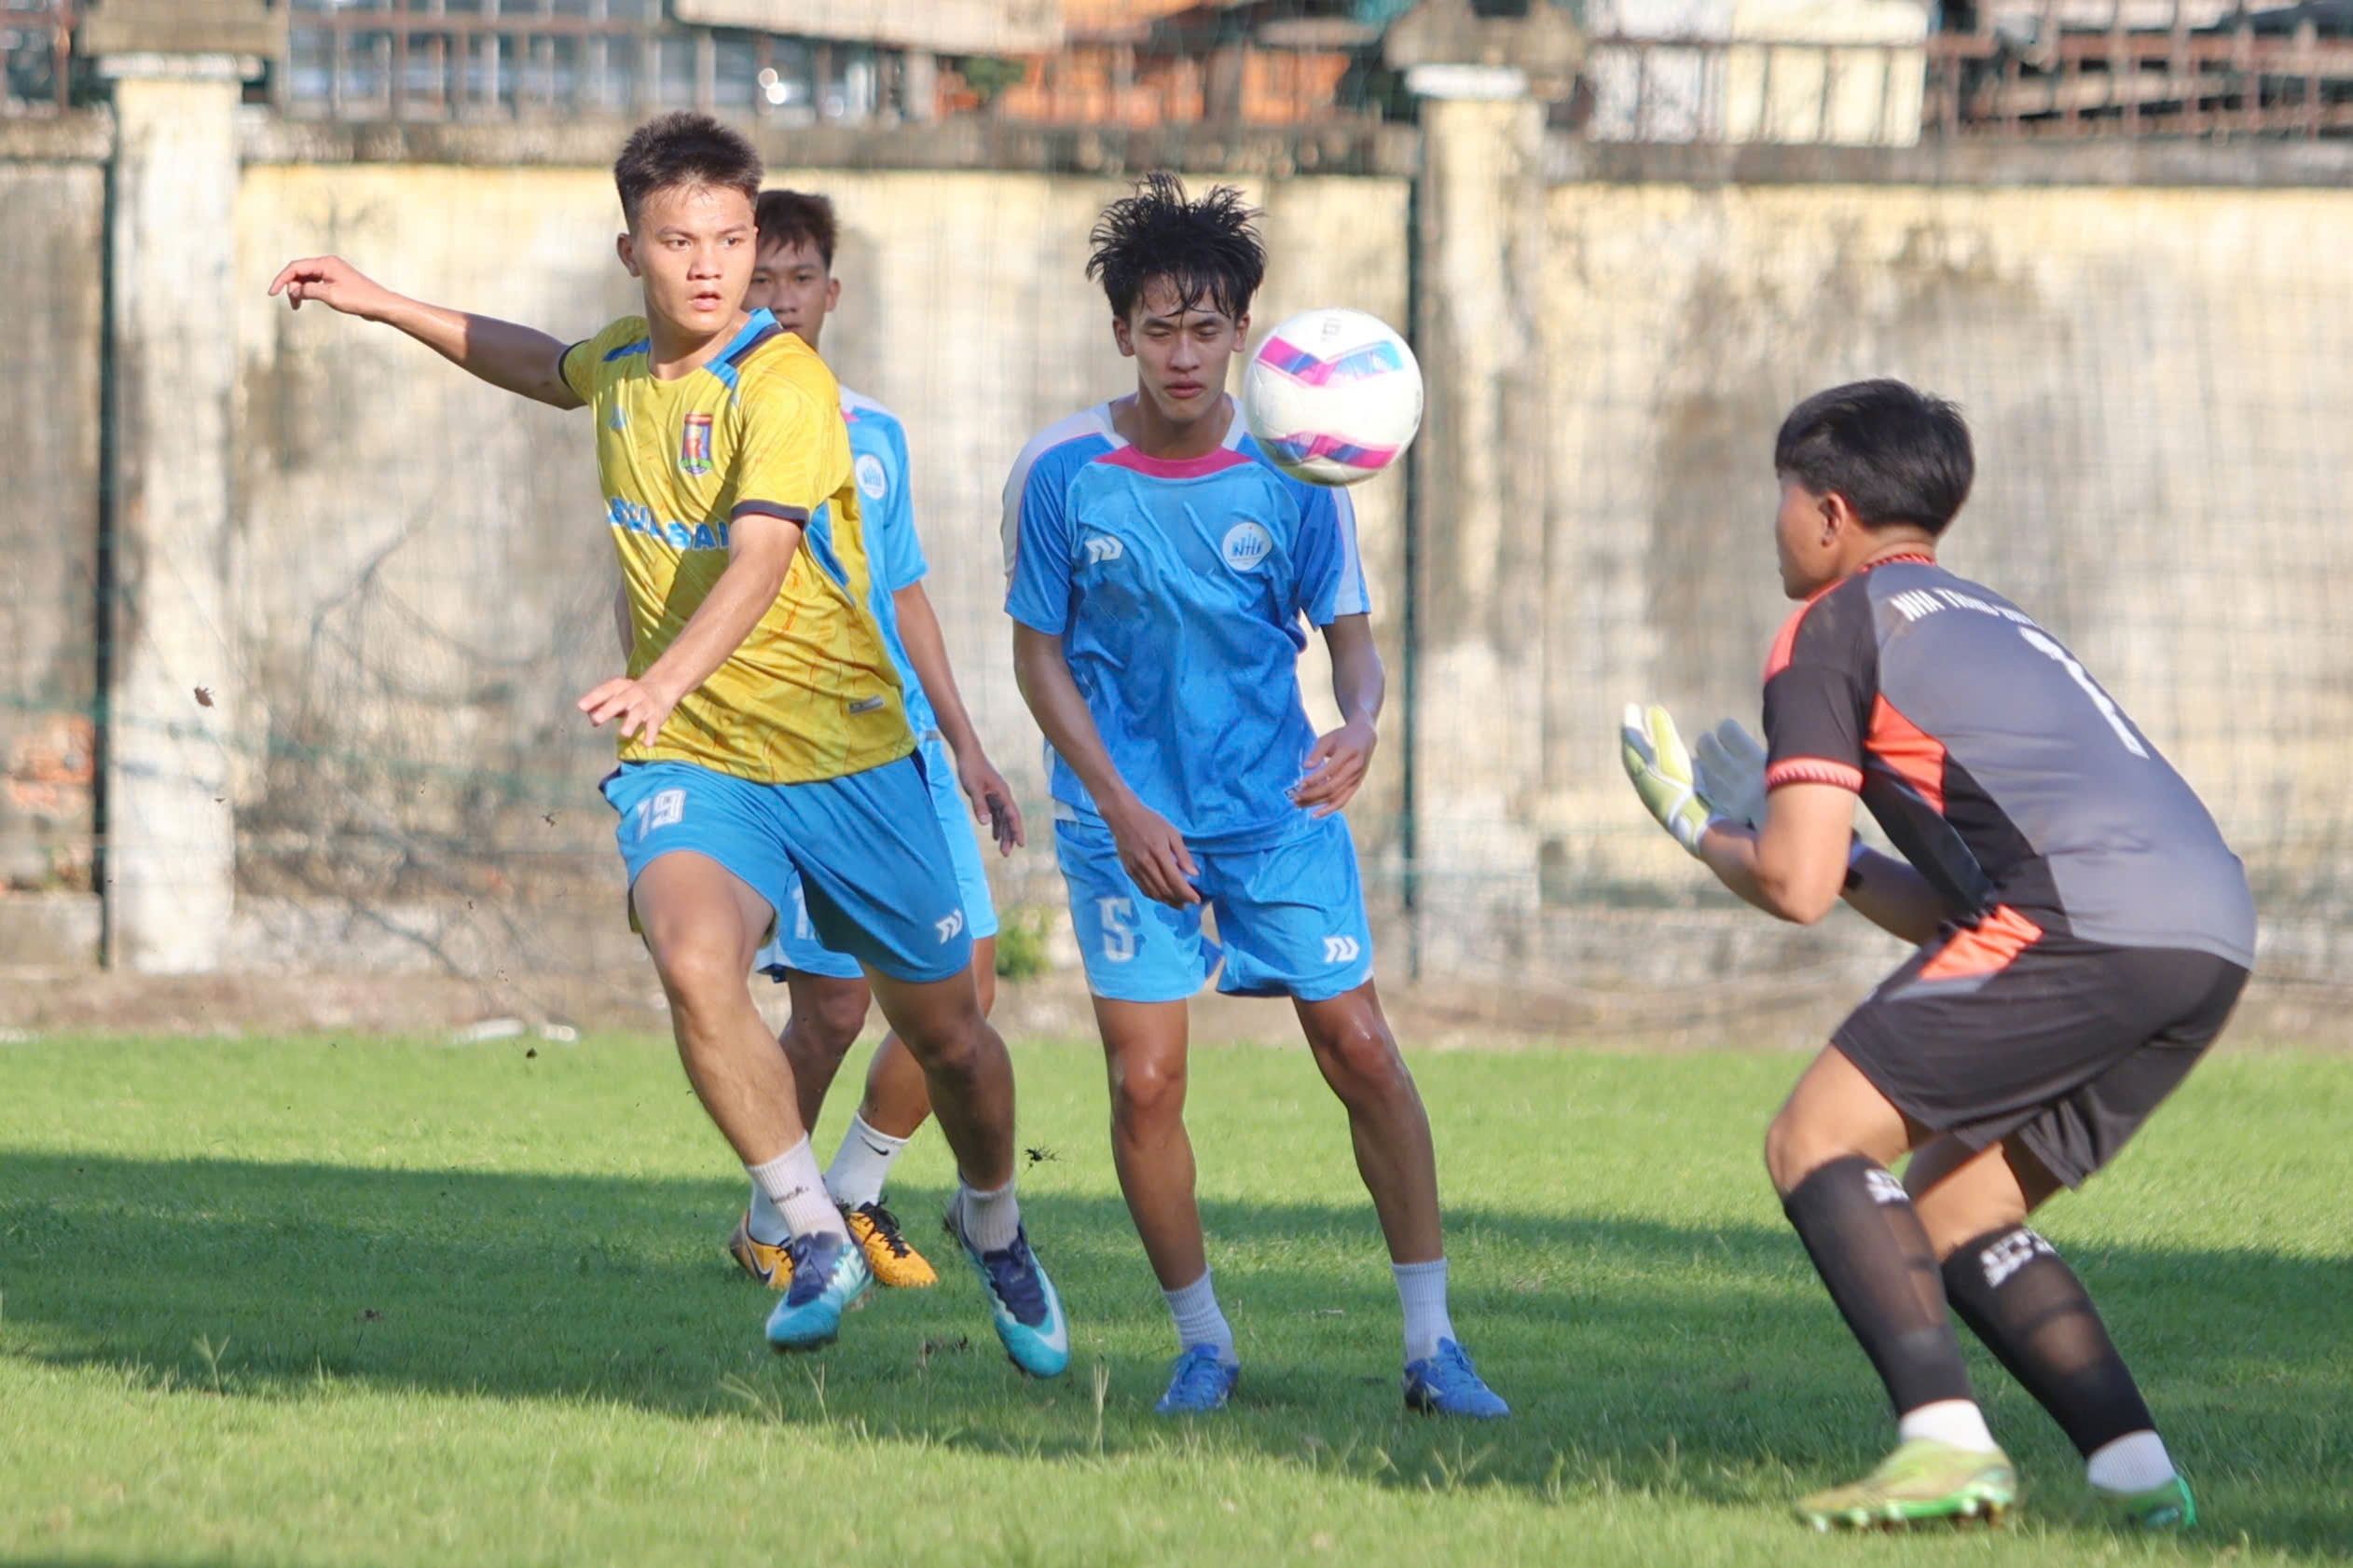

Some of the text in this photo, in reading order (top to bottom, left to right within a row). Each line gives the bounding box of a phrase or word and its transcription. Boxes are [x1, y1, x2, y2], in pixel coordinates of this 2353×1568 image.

[1889, 588, 1947, 622] NHA
[636, 789, 687, 843] 19
[1094, 897, 1135, 963] 5
